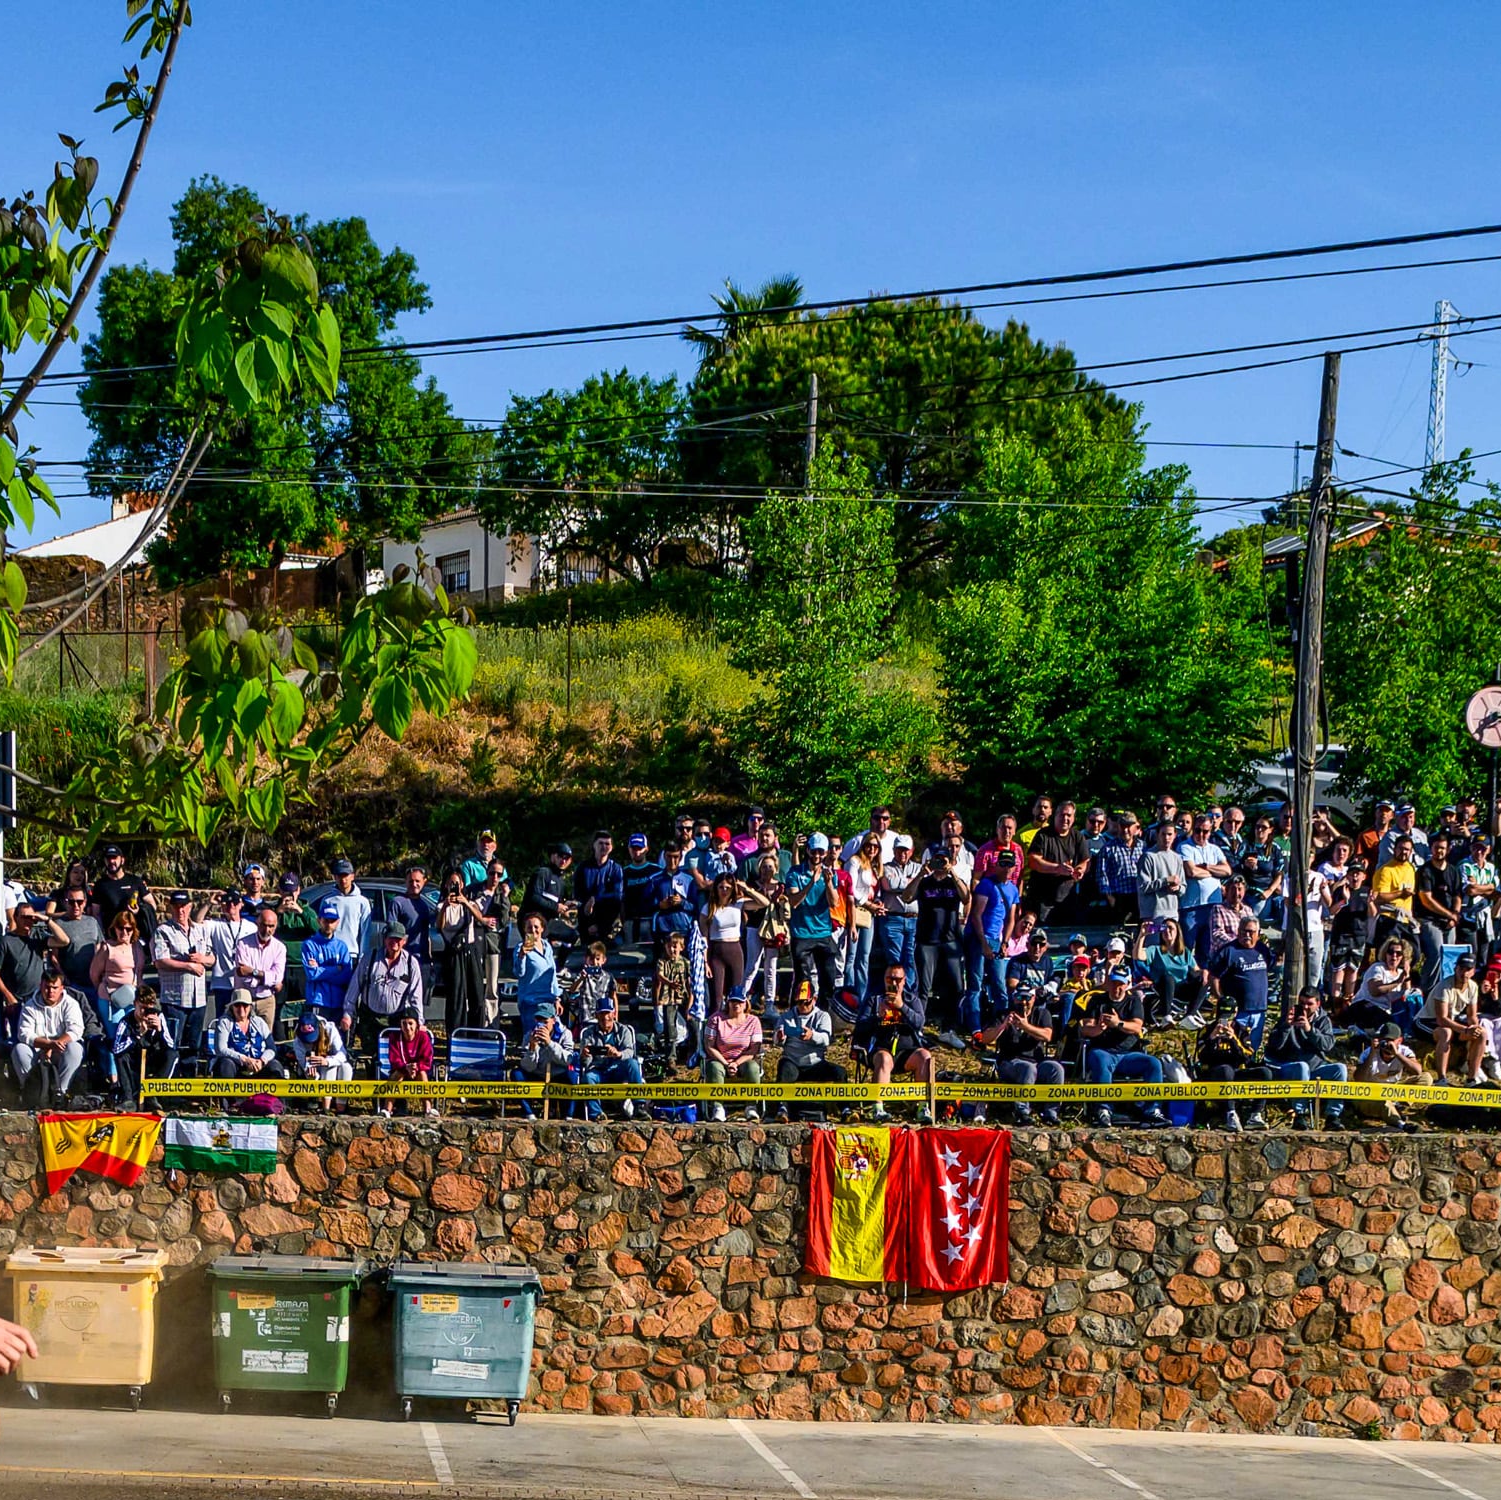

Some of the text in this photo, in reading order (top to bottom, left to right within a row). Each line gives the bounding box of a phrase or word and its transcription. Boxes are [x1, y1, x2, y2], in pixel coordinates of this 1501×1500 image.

[148, 1082, 192, 1093] PUBLICO
[203, 1082, 231, 1093] ZONA
[233, 1082, 277, 1093] PUBLICO
[288, 1082, 316, 1094] ZONA
[318, 1083, 362, 1095] PUBLICO
[373, 1083, 401, 1095] ZONA
[403, 1084, 447, 1095] PUBLICO
[457, 1084, 486, 1095] ZONA
[488, 1085, 531, 1096] PUBLICO
[542, 1085, 568, 1096] ZONA
[570, 1087, 614, 1097] PUBLICO
[625, 1086, 653, 1096] ZONA
[655, 1087, 699, 1097] PUBLICO
[710, 1087, 738, 1097] ZONA
[740, 1087, 784, 1097] PUBLICO
[795, 1087, 823, 1097] ZONA
[825, 1086, 869, 1097] PUBLICO
[880, 1086, 906, 1096] ZONA
[908, 1086, 951, 1097] PUBICO
[963, 1086, 991, 1096] ZONA
[993, 1087, 1037, 1098] PUBLICO
[1048, 1087, 1076, 1098] ZONA
[1078, 1087, 1122, 1098] PUBLICO
[1134, 1086, 1162, 1097] ZONA
[1164, 1085, 1208, 1096] PUBLICO
[1219, 1085, 1246, 1096] ZONA
[1248, 1084, 1291, 1095] PUBLICO
[1329, 1084, 1371, 1097] PUBLICO
[1381, 1087, 1406, 1098] ZONA
[1408, 1089, 1449, 1101] PUBLICO
[1458, 1091, 1483, 1103] ZONA
